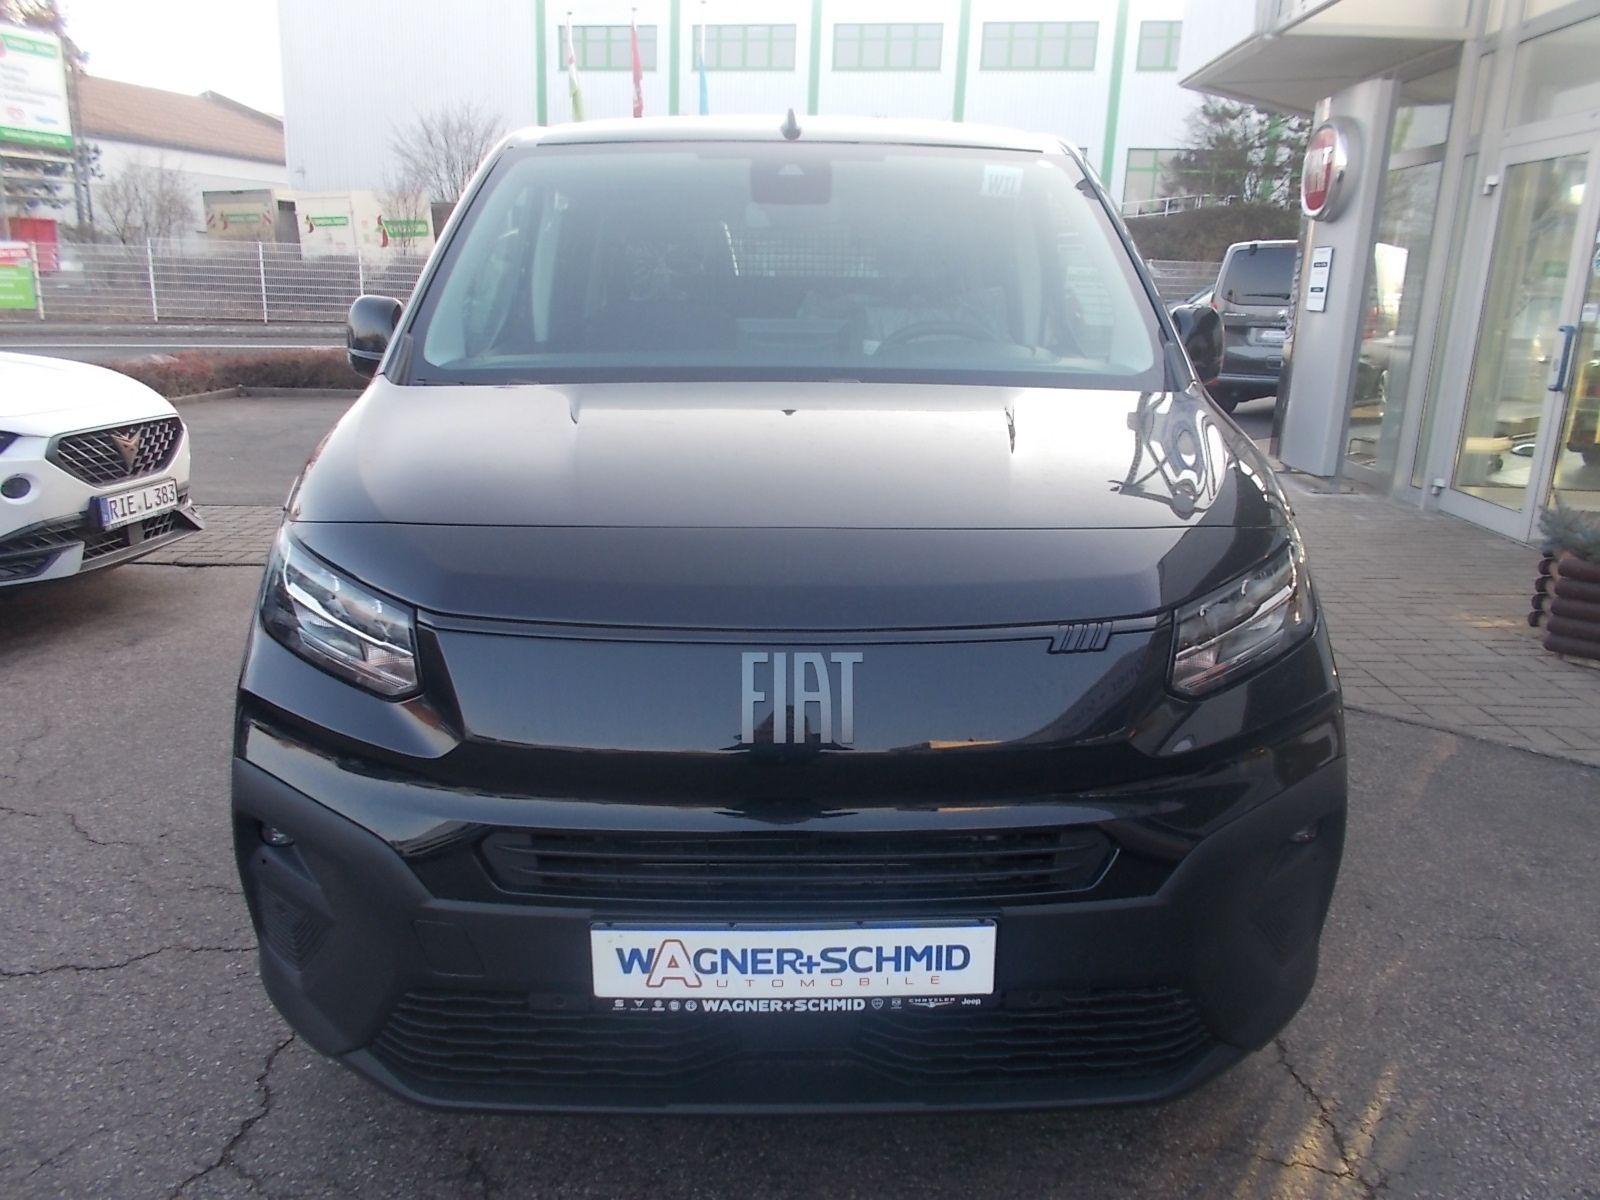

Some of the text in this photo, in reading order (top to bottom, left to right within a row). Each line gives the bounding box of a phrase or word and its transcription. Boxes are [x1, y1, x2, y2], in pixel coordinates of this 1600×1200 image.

[109, 495, 137, 520] RIE
[741, 651, 864, 744] FIAT
[702, 999, 867, 1013] WAGNER+SCHMID
[960, 997, 982, 1006] Jeep
